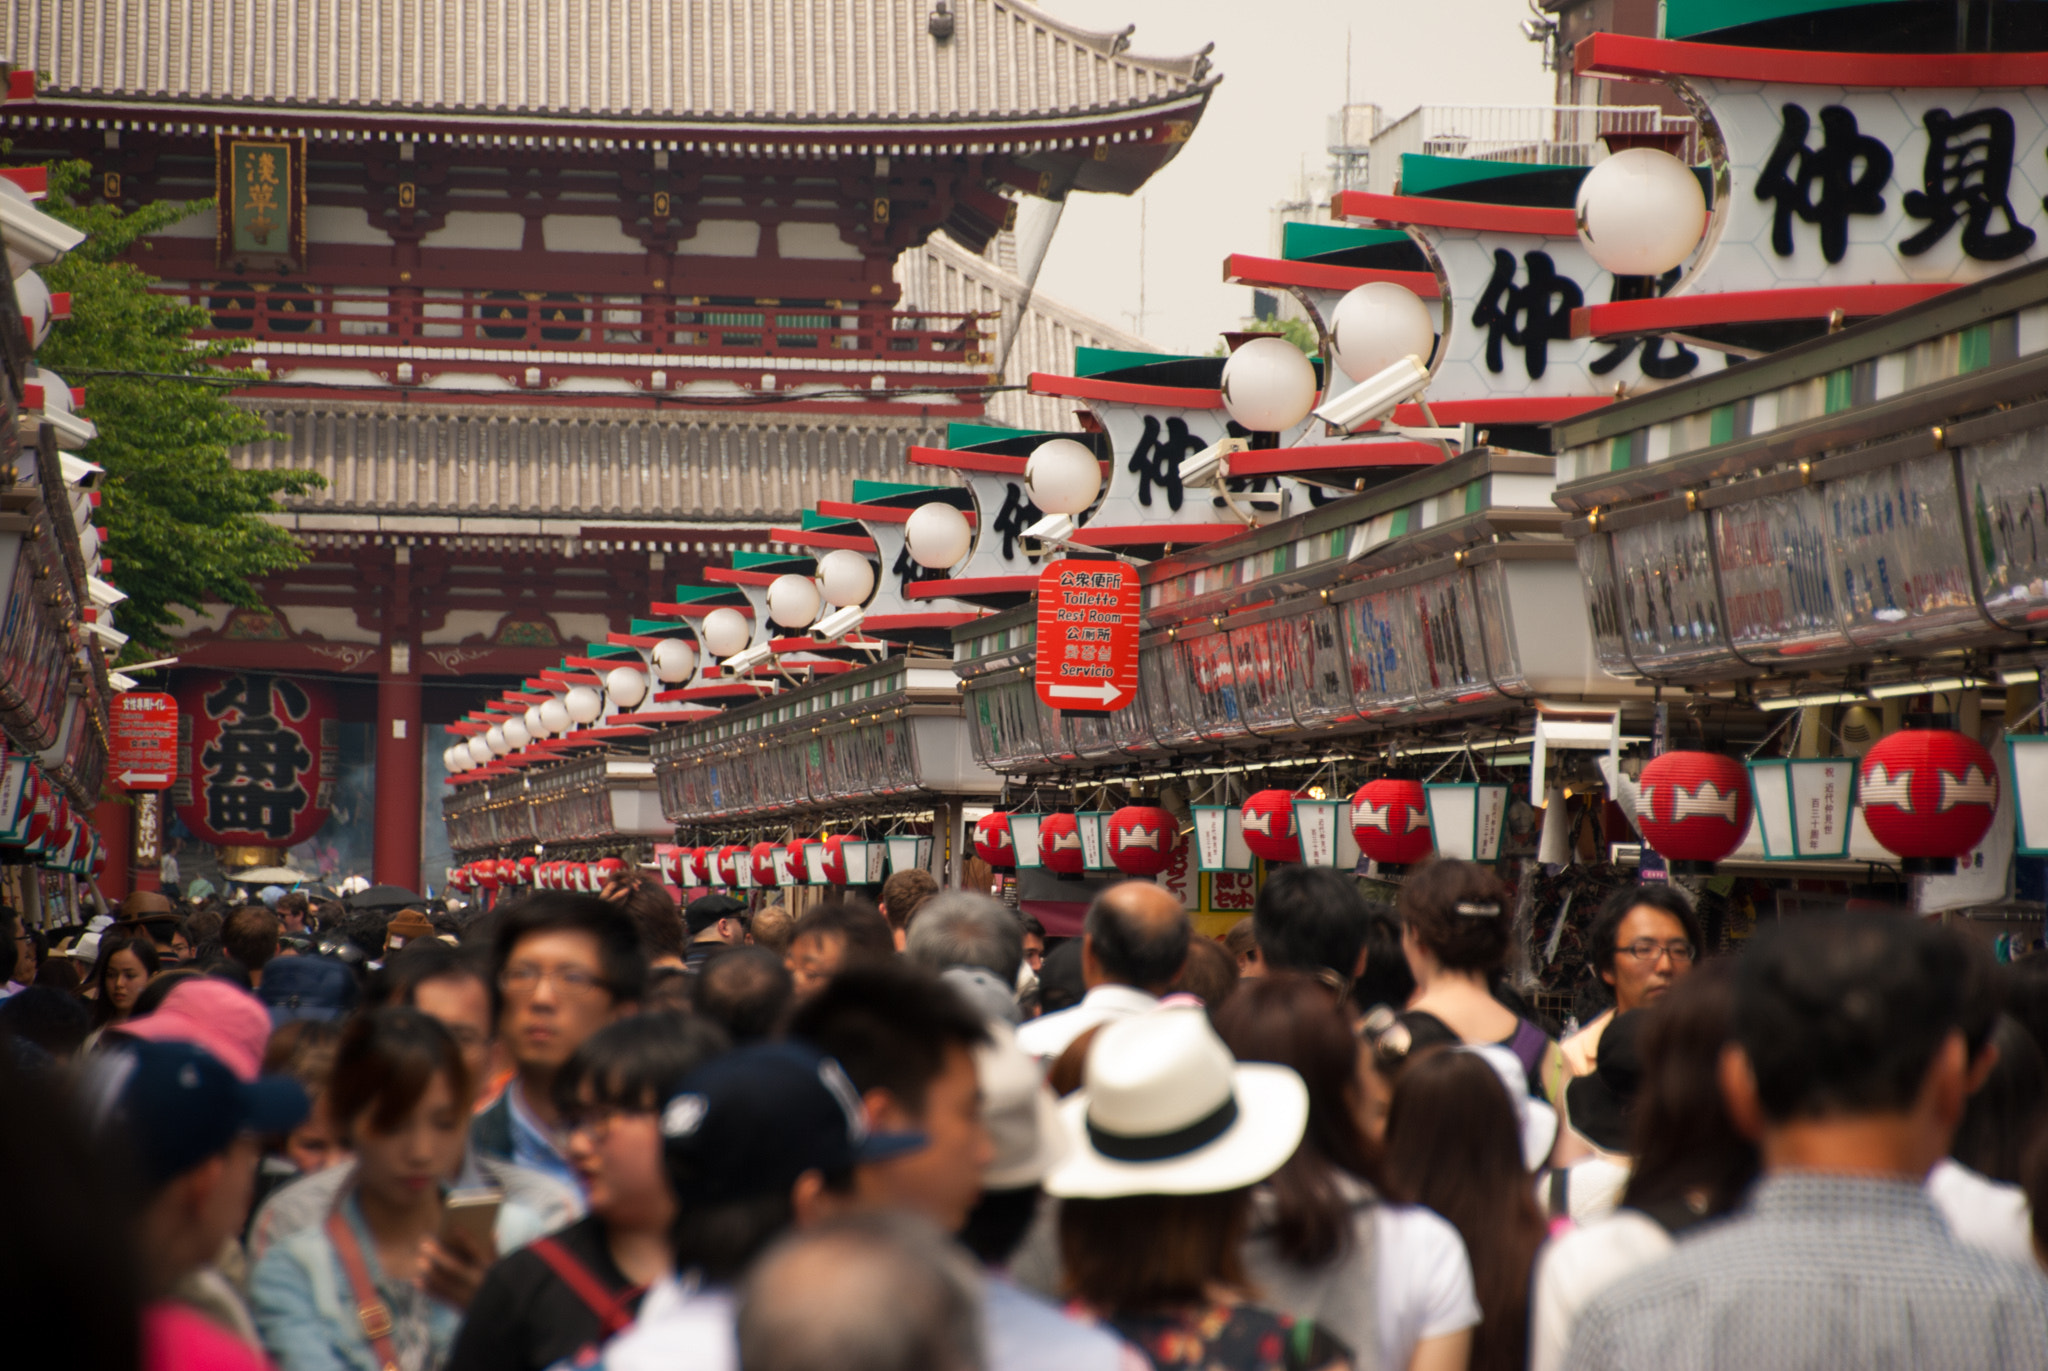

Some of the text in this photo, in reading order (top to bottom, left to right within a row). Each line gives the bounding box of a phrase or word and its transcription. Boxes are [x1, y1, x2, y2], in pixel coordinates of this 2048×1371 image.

[1755, 103, 2048, 263] 仲見
[1060, 572, 1122, 589] 公衆便所
[1063, 592, 1118, 606] Toilette
[1057, 609, 1122, 623] Rest Room
[1064, 645, 1112, 661] 화장실
[1060, 664, 1114, 677] Servicio
[202, 673, 312, 839] 小舟町
